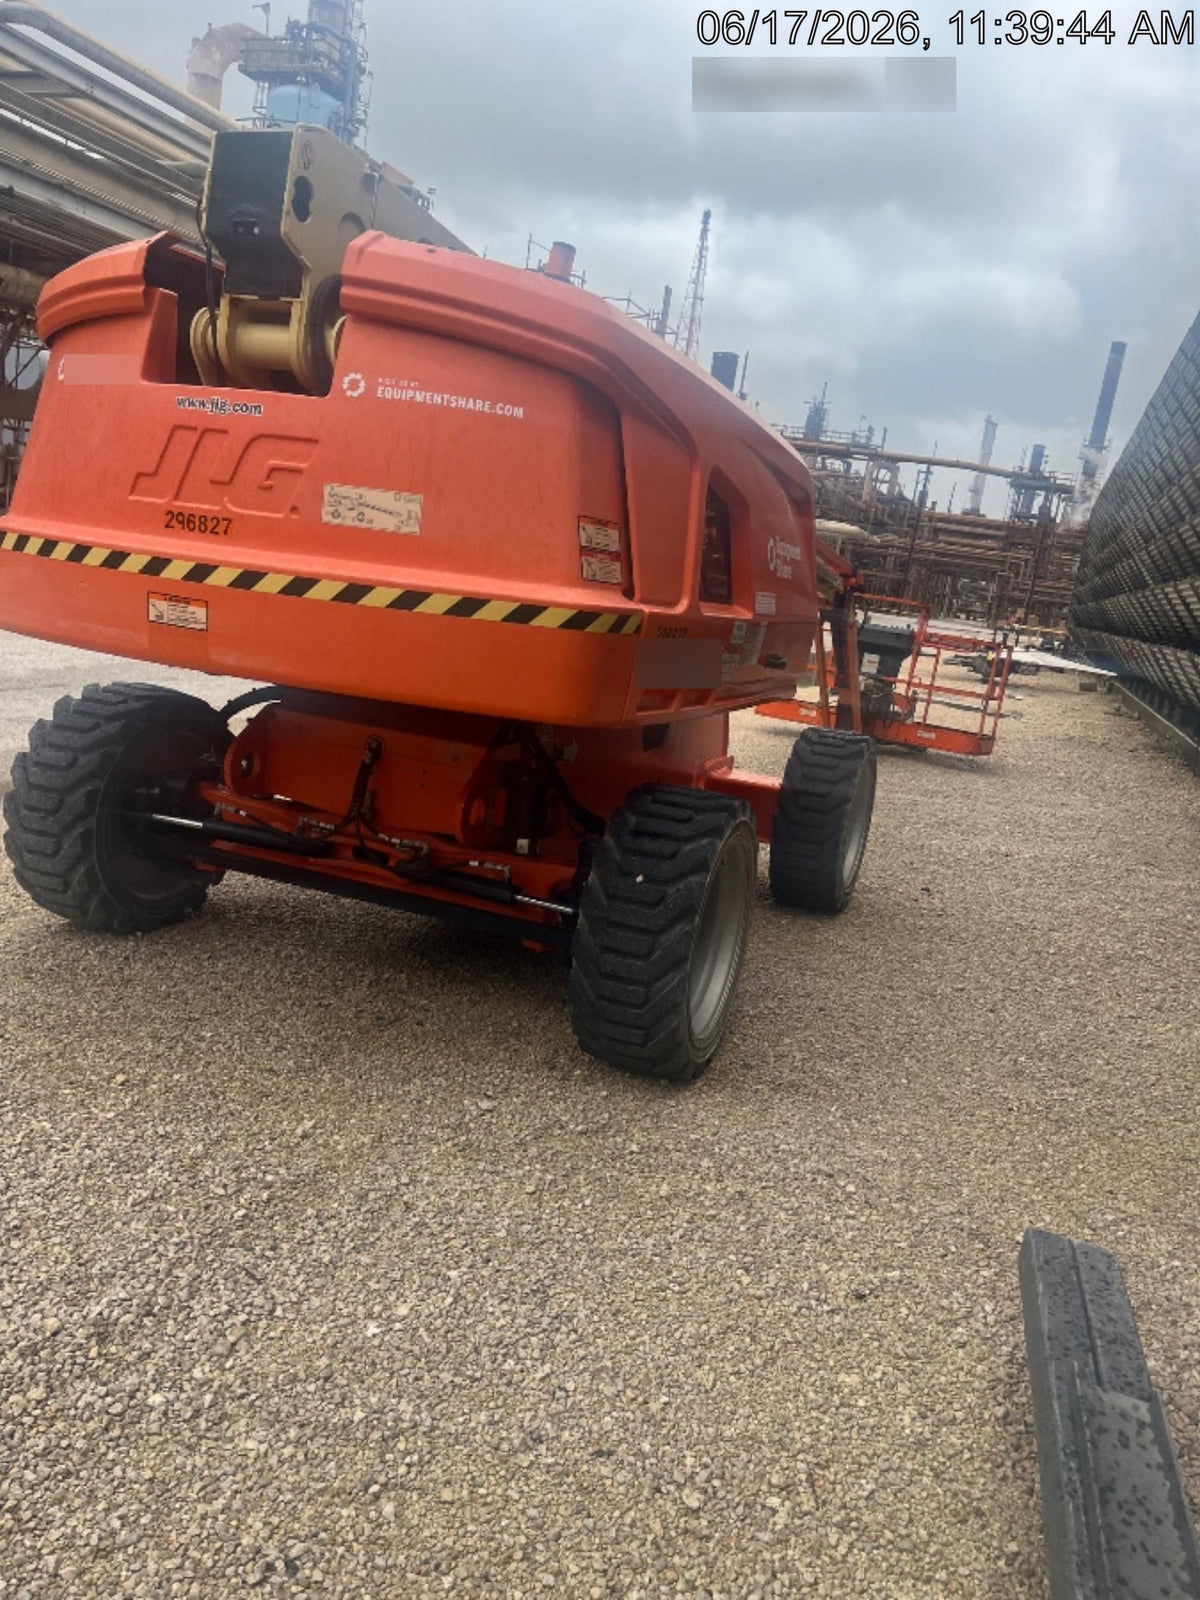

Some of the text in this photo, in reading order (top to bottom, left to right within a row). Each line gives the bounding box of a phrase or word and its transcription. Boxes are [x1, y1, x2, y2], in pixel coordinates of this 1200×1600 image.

[176, 396, 263, 416] www.jlg.com
[376, 386, 524, 419] EQUIPMENTSHARE.COM
[164, 510, 233, 536] 296827
